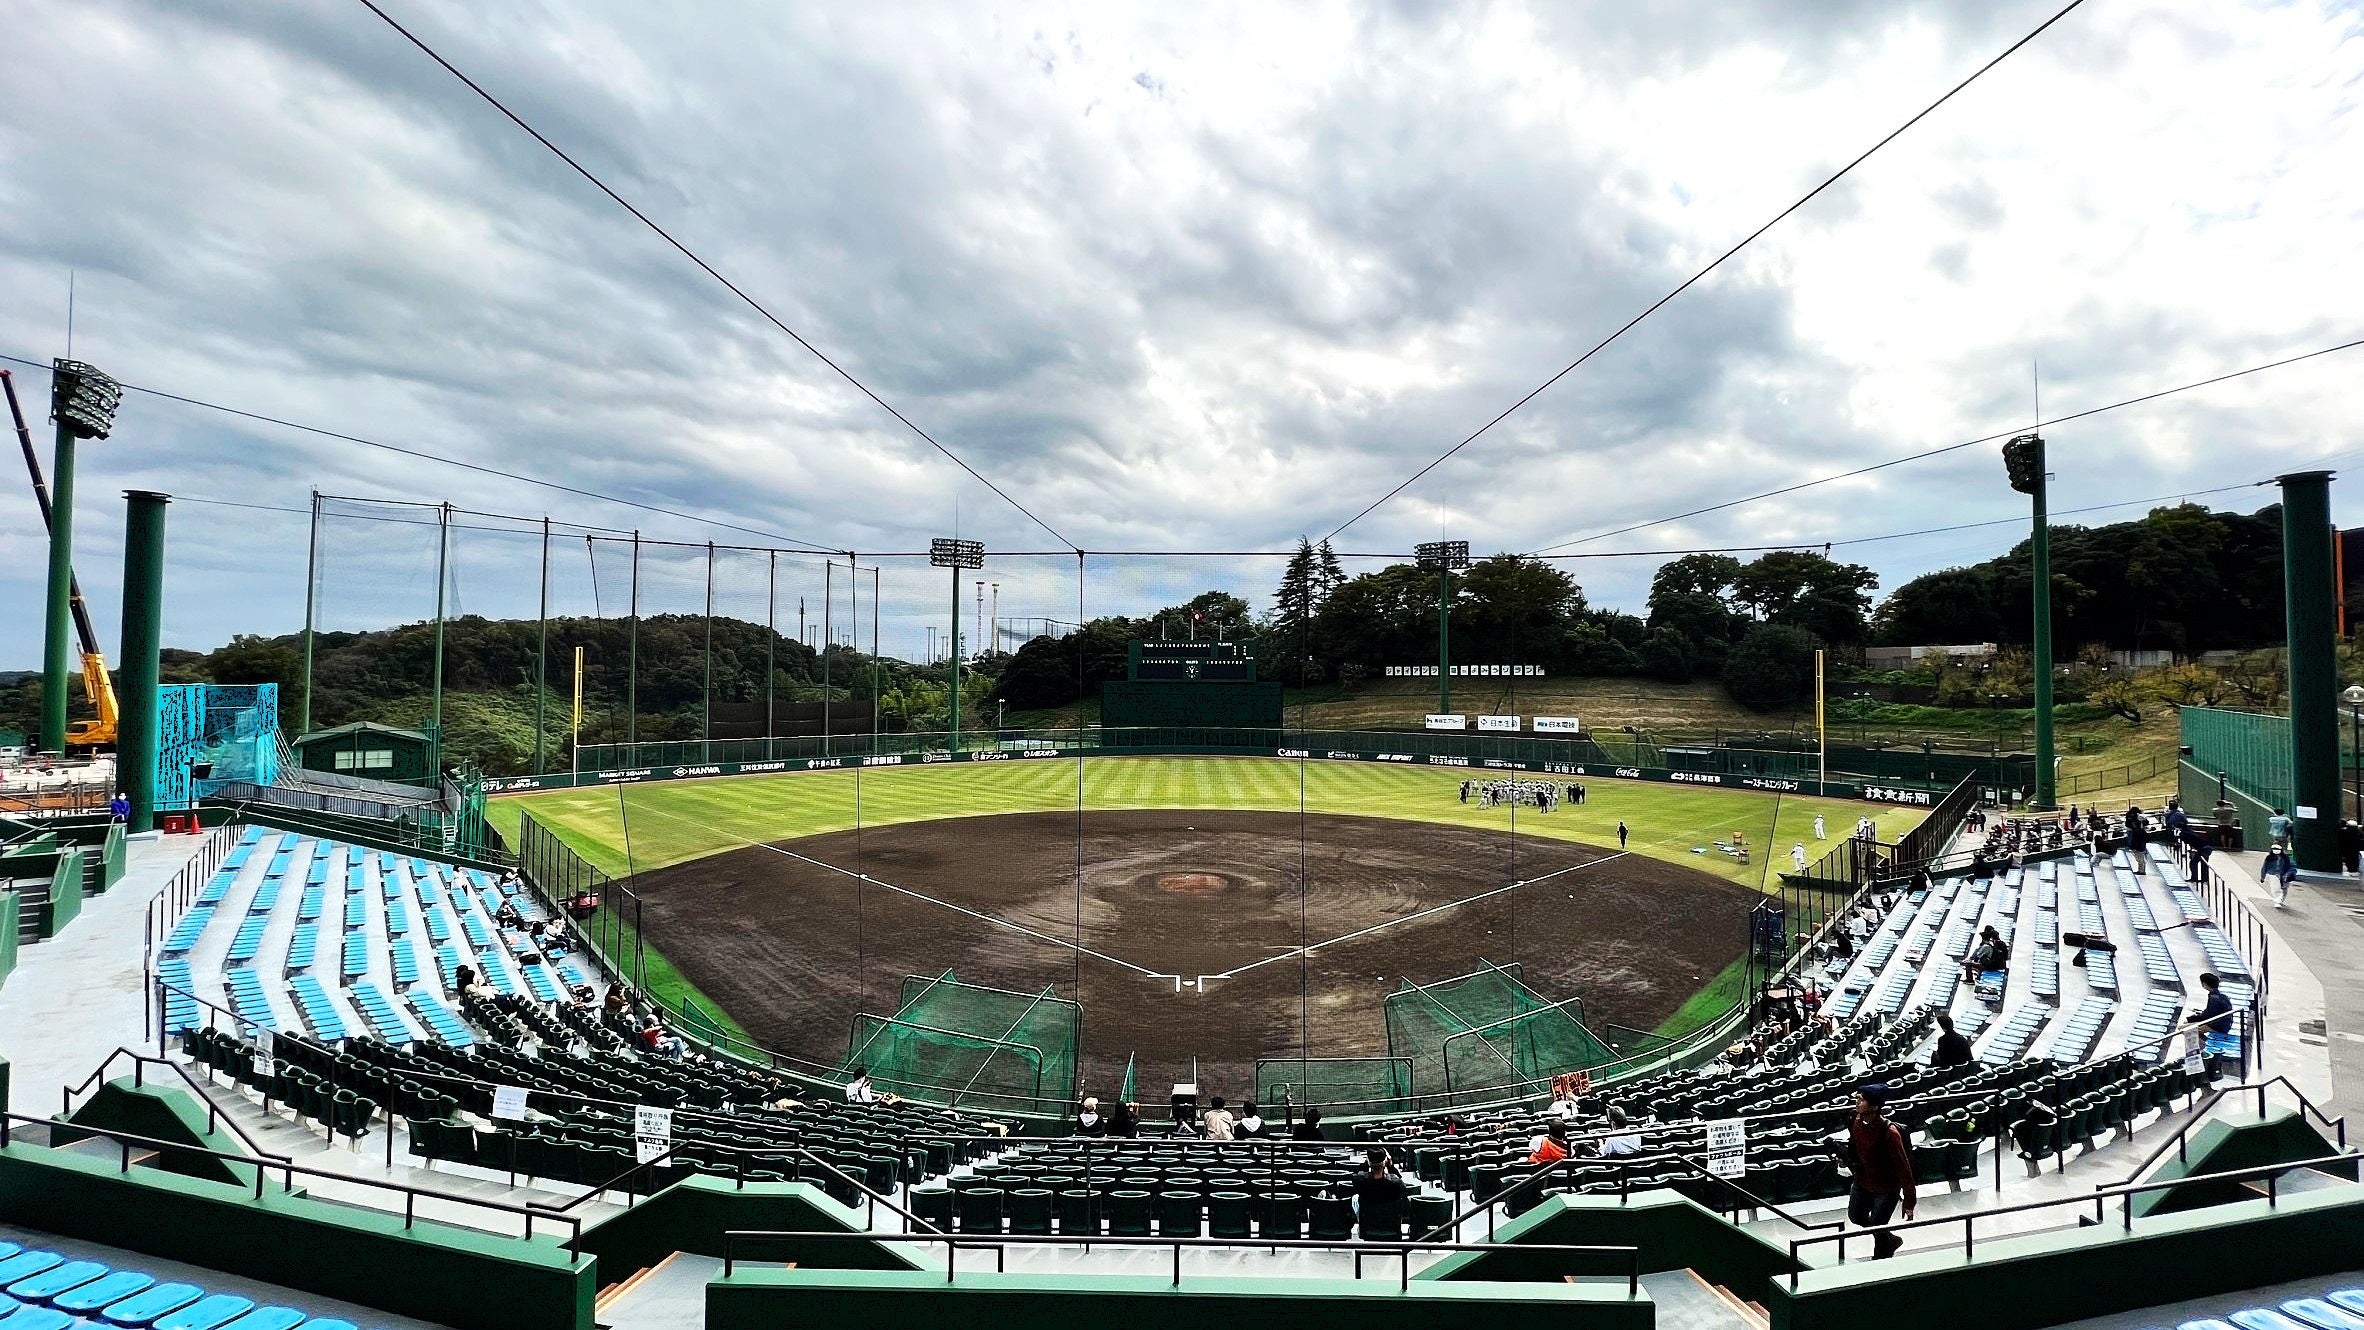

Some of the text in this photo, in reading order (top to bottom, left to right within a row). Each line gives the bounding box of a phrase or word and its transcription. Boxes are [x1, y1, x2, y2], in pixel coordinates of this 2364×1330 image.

[1277, 748, 1309, 758] Canon
[688, 766, 721, 775] HANWA
[480, 781, 504, 792] 日テレ
